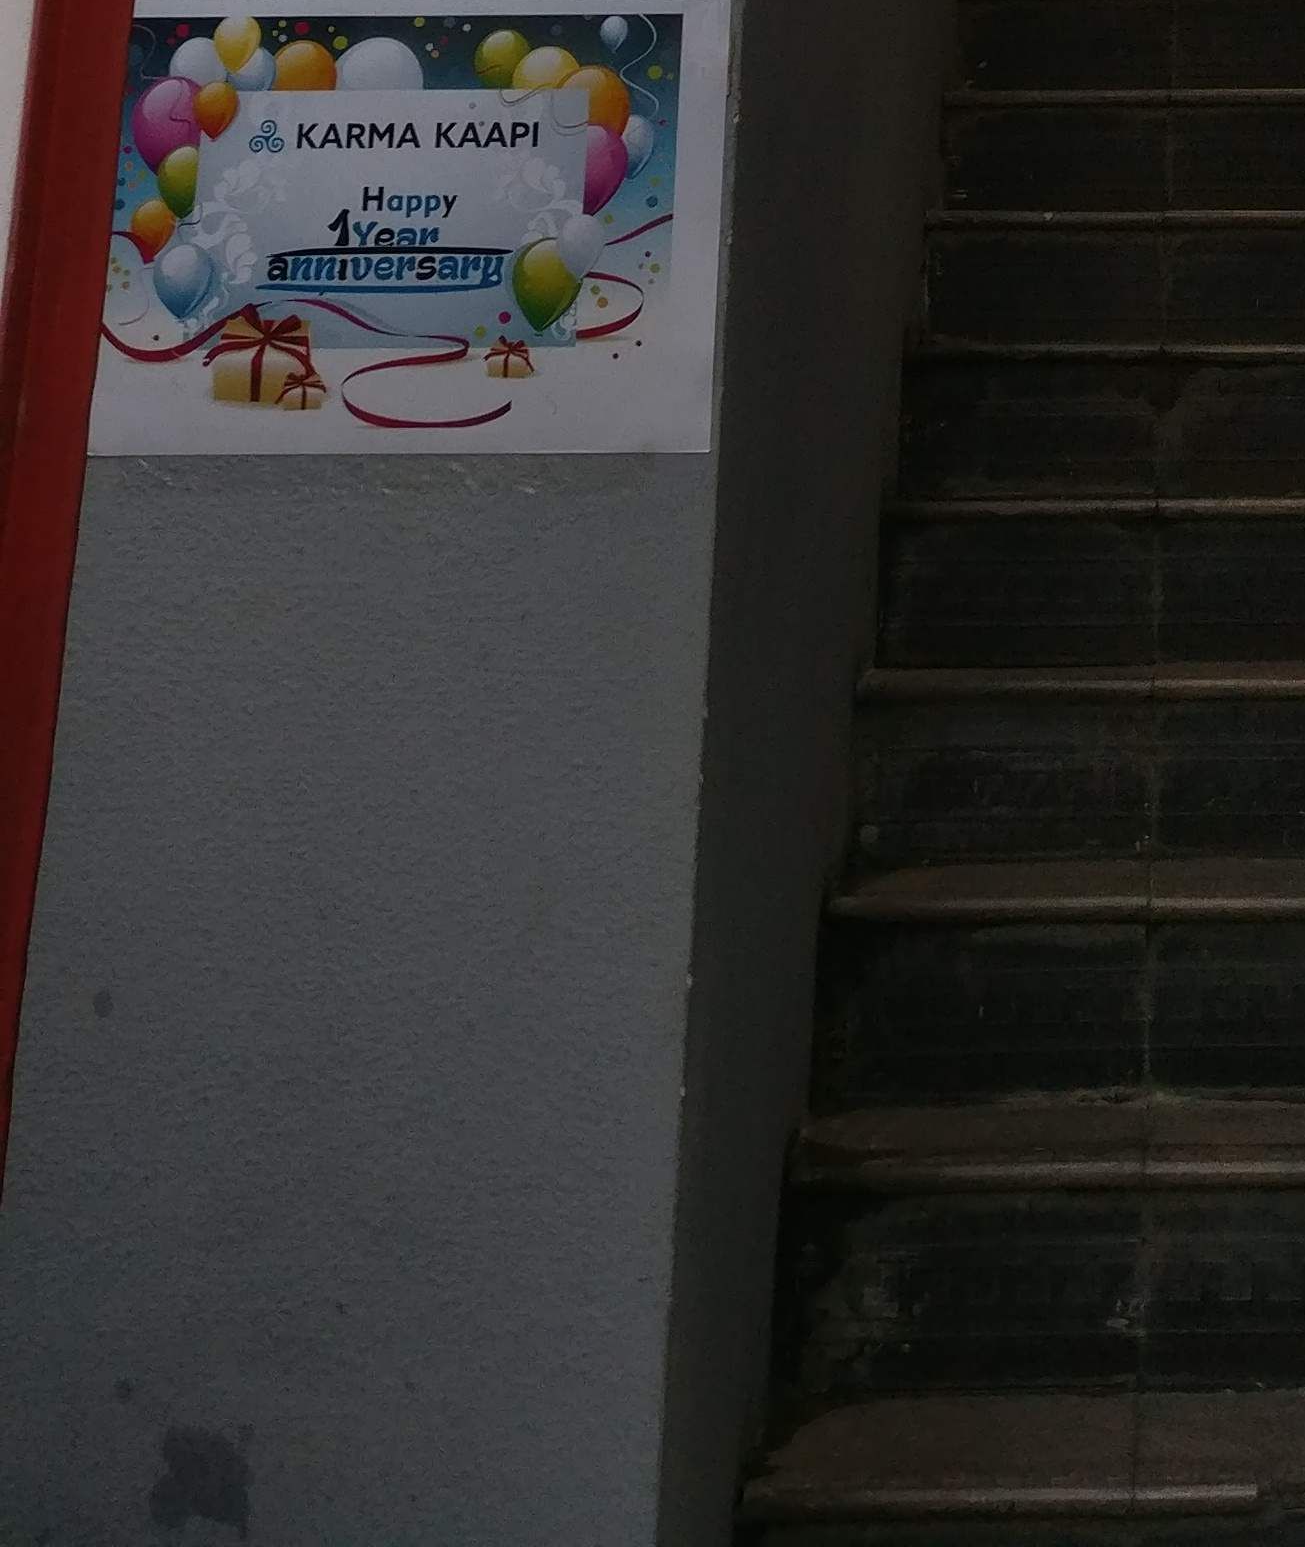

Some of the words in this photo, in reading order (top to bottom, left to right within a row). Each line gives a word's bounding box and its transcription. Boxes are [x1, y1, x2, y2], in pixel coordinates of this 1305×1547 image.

[296, 122, 421, 149] KARMA
[434, 120, 540, 149] KAAPI
[361, 186, 458, 218] Happy
[266, 254, 505, 291] anniversary
